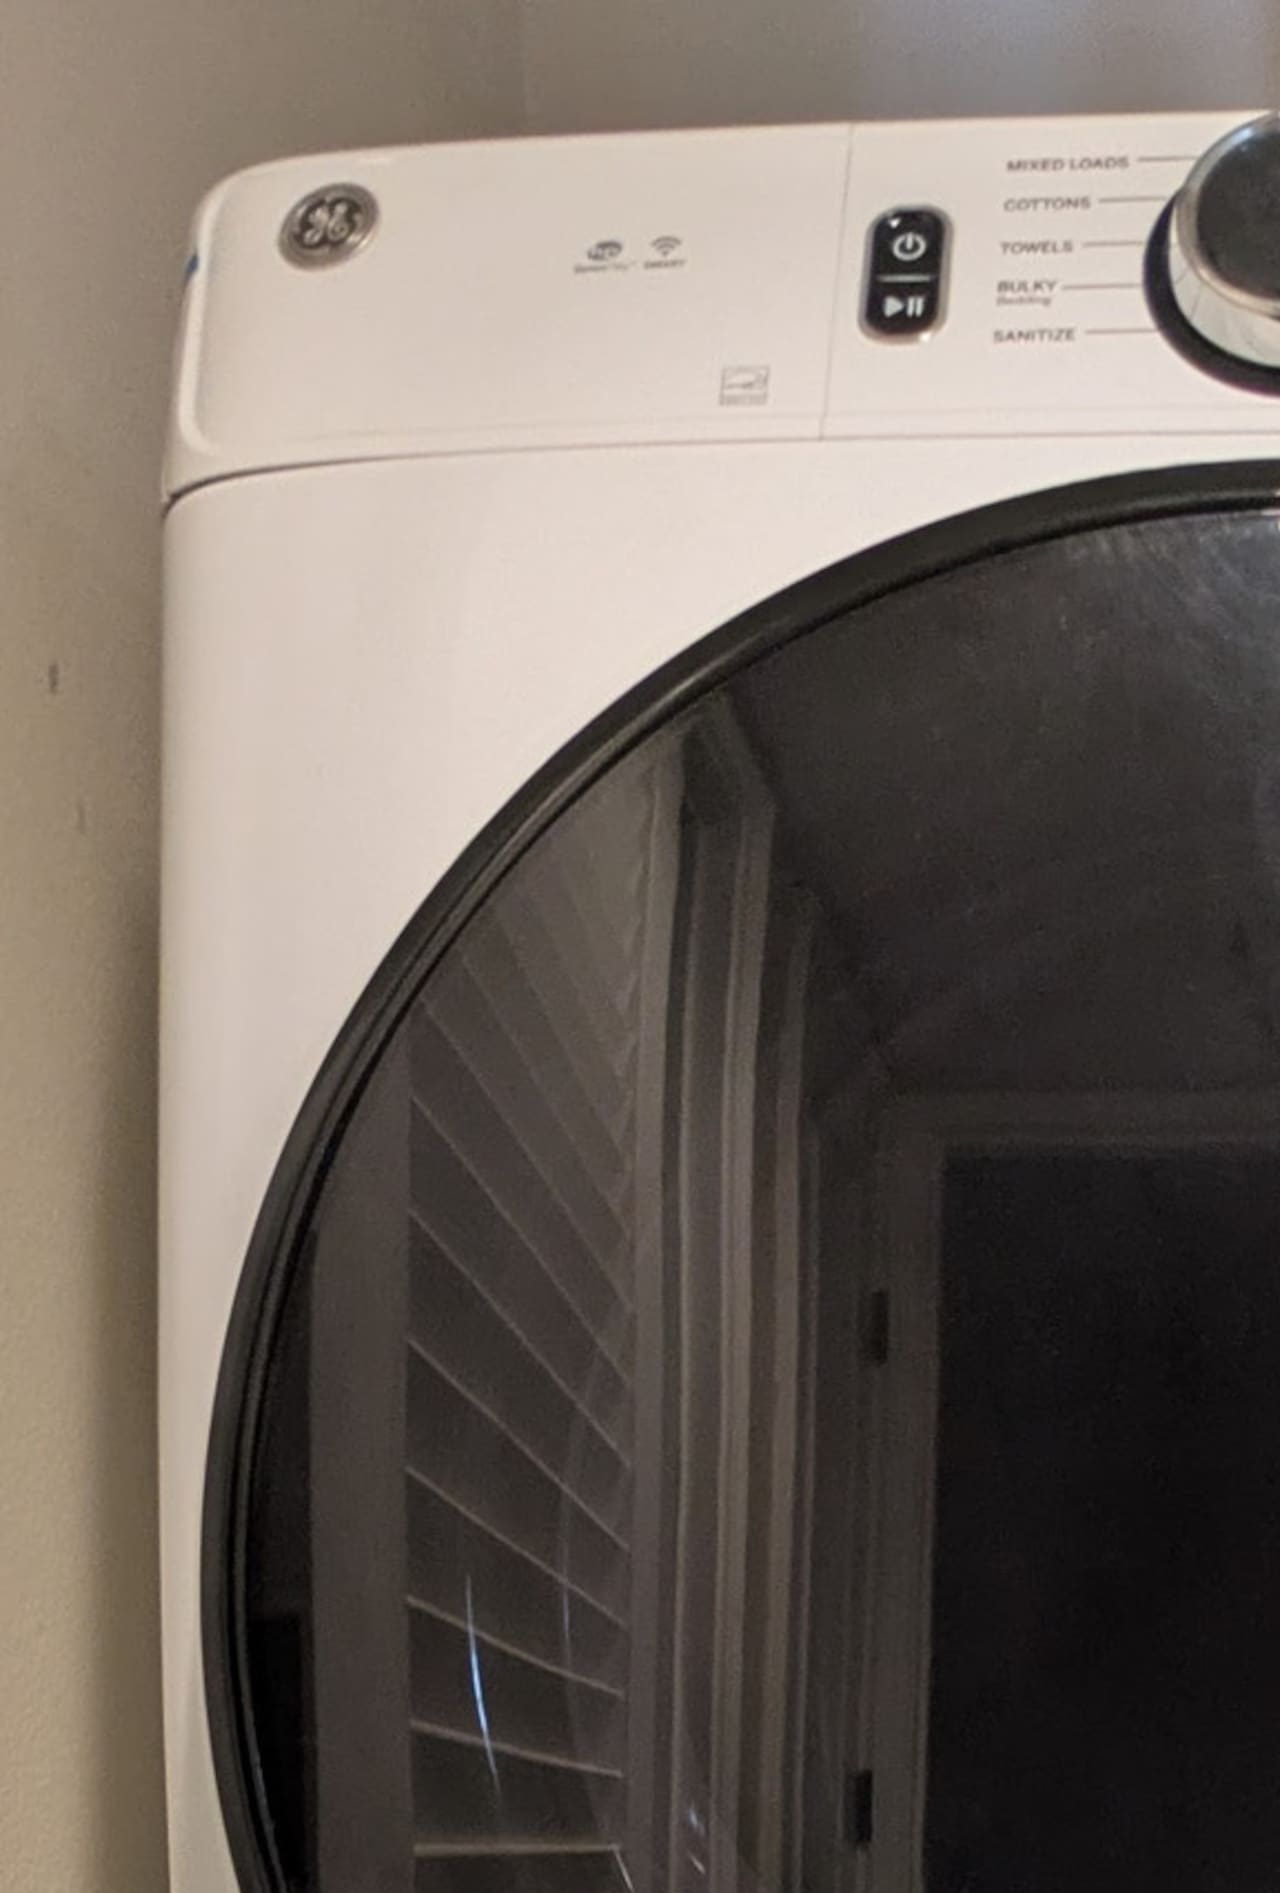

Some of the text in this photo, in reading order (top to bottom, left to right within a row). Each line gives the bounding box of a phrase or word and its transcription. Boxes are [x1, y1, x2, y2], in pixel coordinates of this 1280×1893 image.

[1006, 156, 1129, 172] MIXED LOADS
[1003, 197, 1091, 212] COTTONS
[1000, 240, 1074, 255] TOWELS
[996, 279, 1057, 293] BULKY
[993, 328, 1075, 343] SANITIZE
